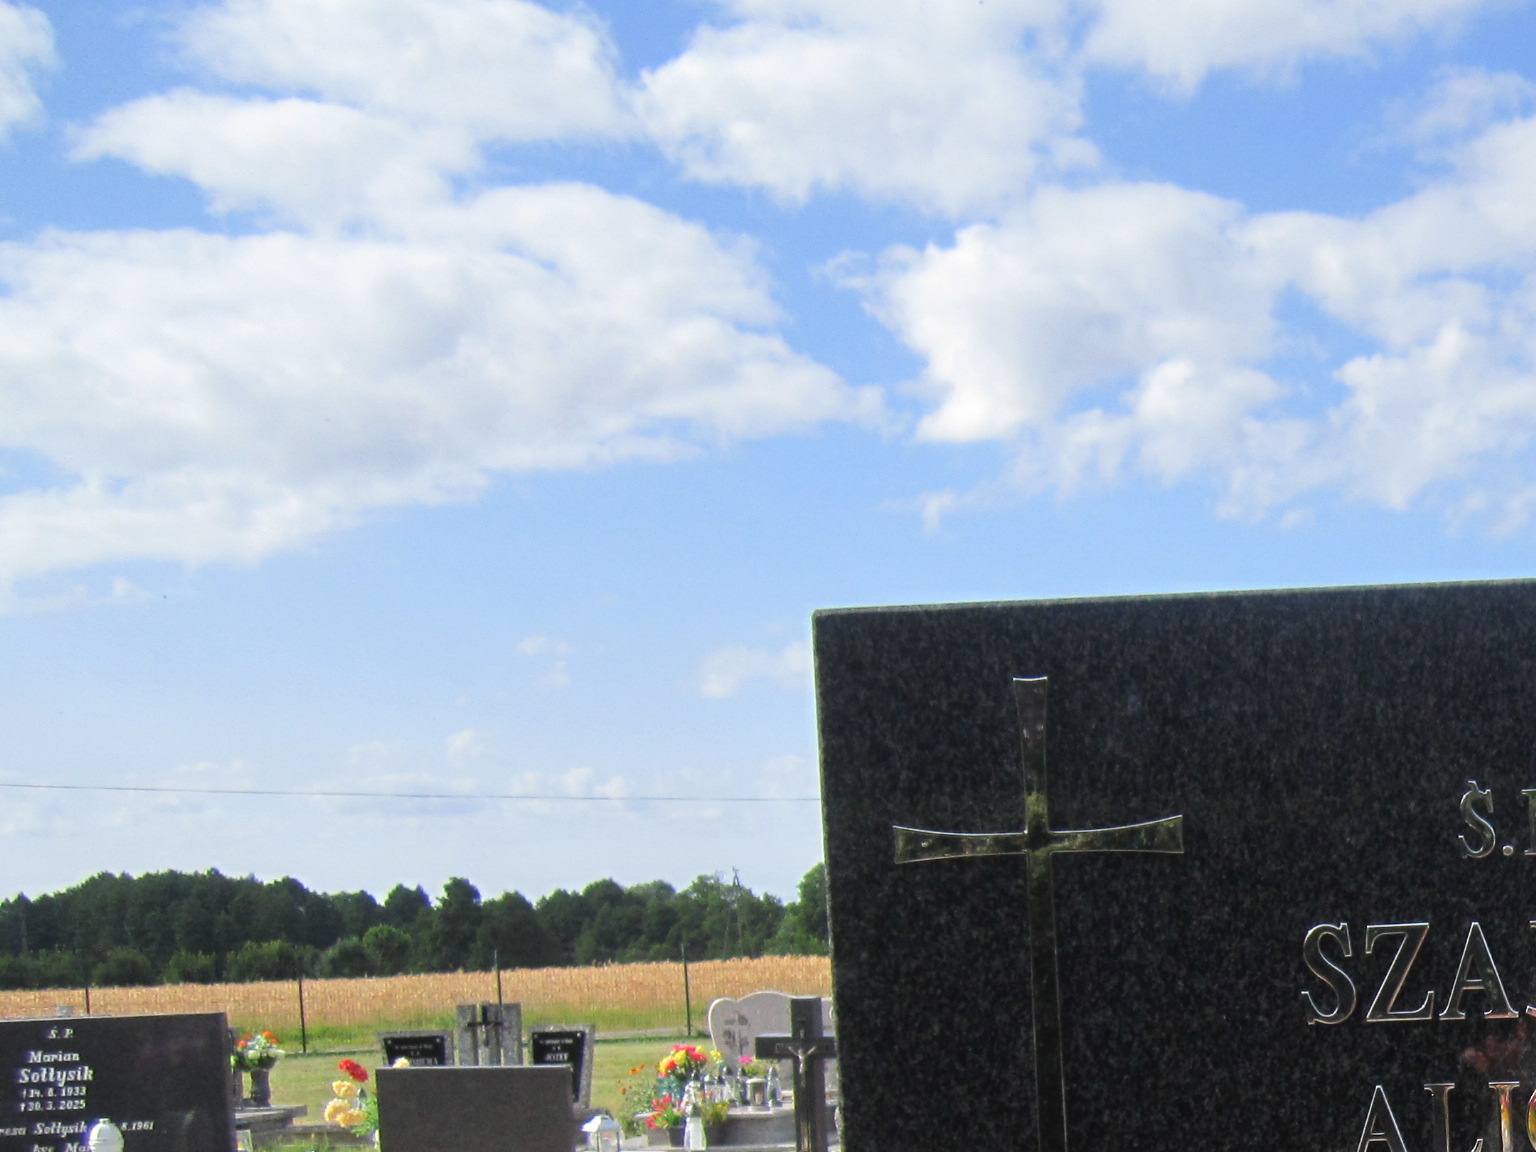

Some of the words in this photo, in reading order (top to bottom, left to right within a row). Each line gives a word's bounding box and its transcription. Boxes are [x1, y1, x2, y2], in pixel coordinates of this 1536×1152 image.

[28, 1050, 80, 1063] Marian
[60, 1086, 87, 1097] 1933
[59, 1100, 86, 1110] 2025
